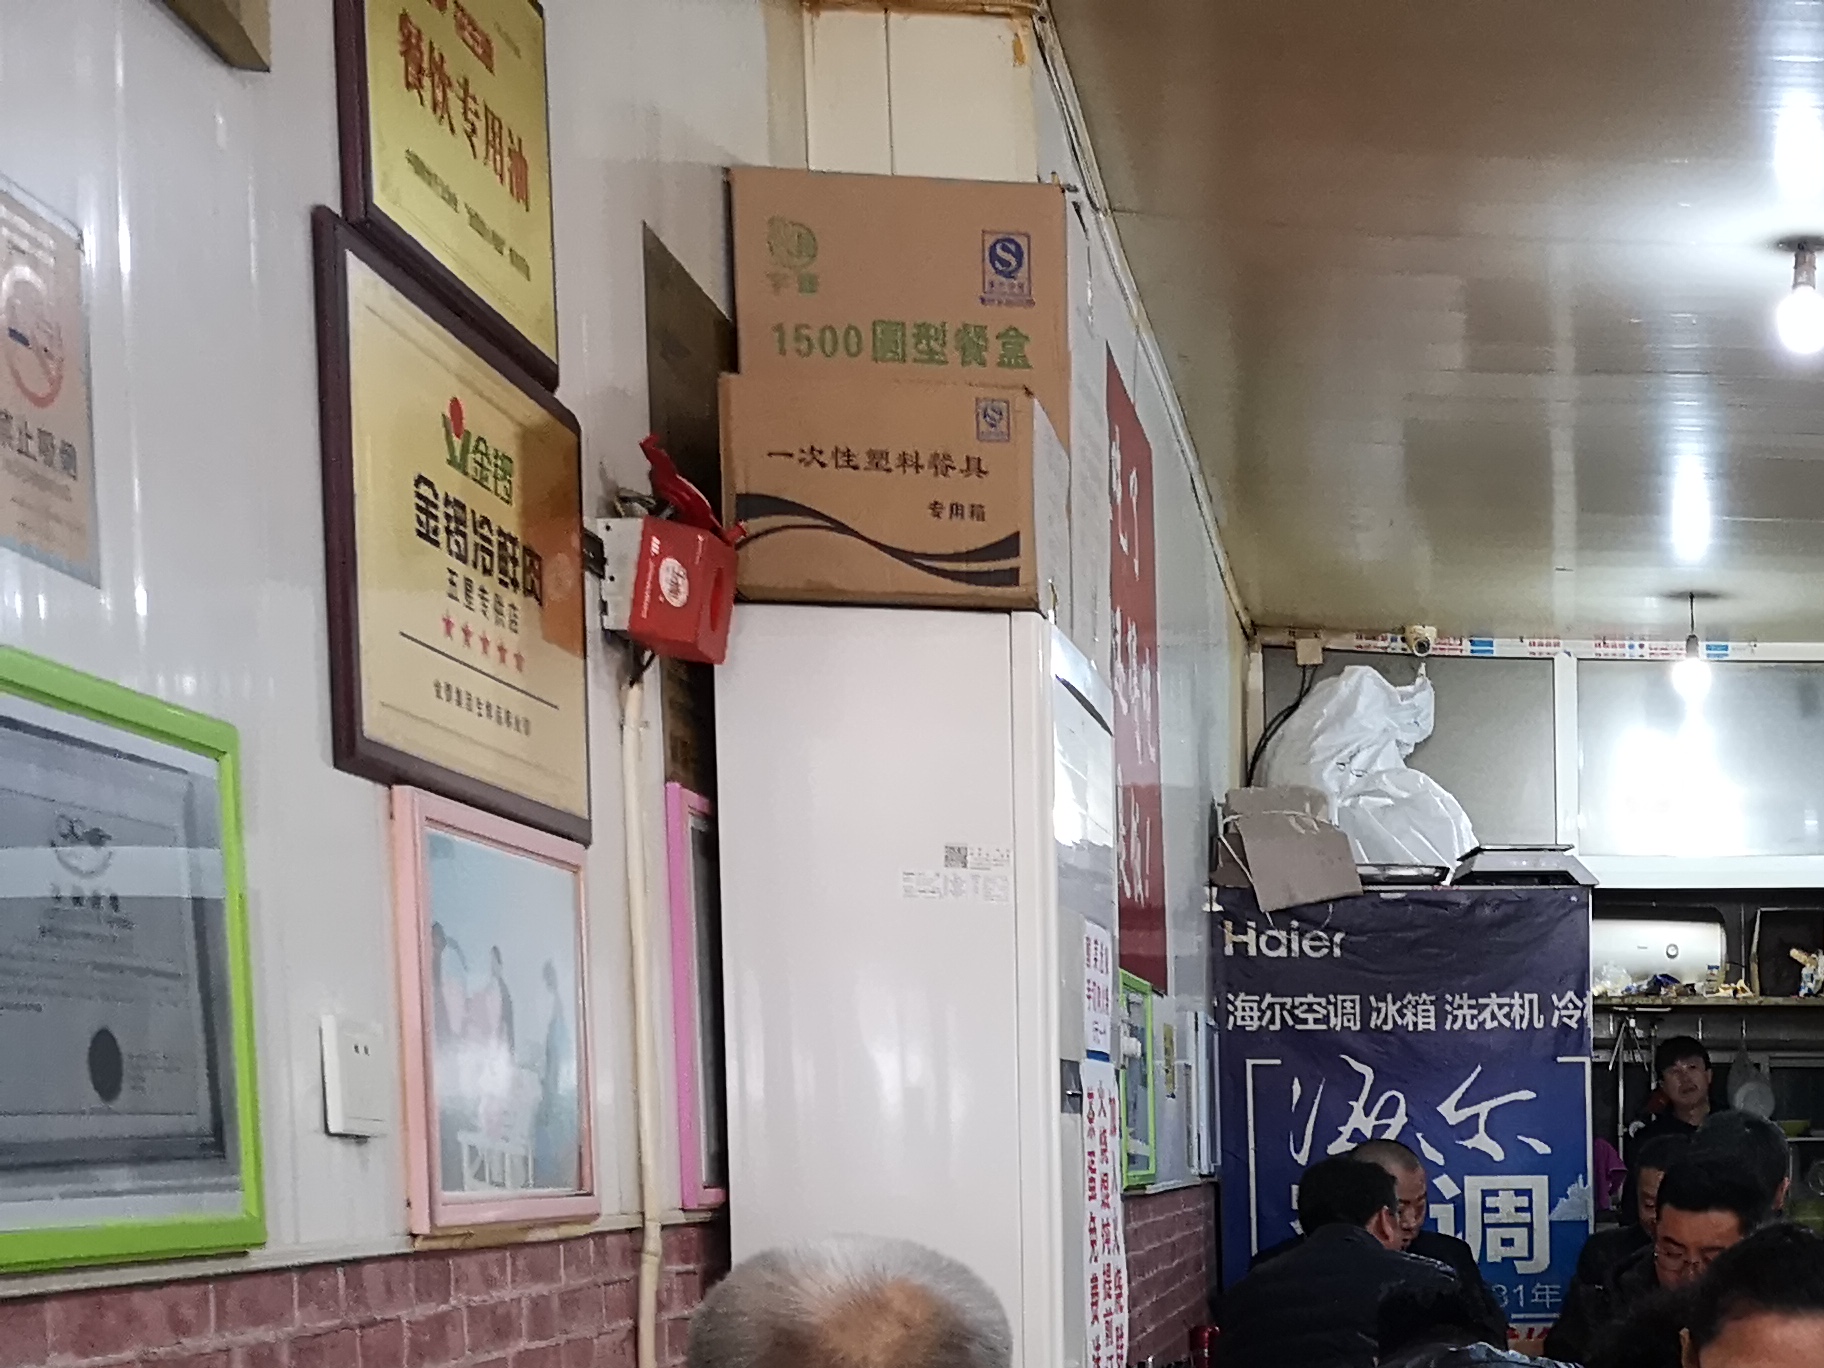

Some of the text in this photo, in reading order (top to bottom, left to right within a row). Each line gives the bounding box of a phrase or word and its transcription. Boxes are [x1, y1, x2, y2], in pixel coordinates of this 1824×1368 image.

[766, 445, 989, 479] 一次性塑料餐具
[928, 499, 987, 523] 专用箱
[1222, 919, 1347, 959] Haier
[1225, 991, 1362, 1032] 海尔空调
[1369, 992, 1437, 1032] 冰箱
[1443, 990, 1545, 1031] 洗衣机
